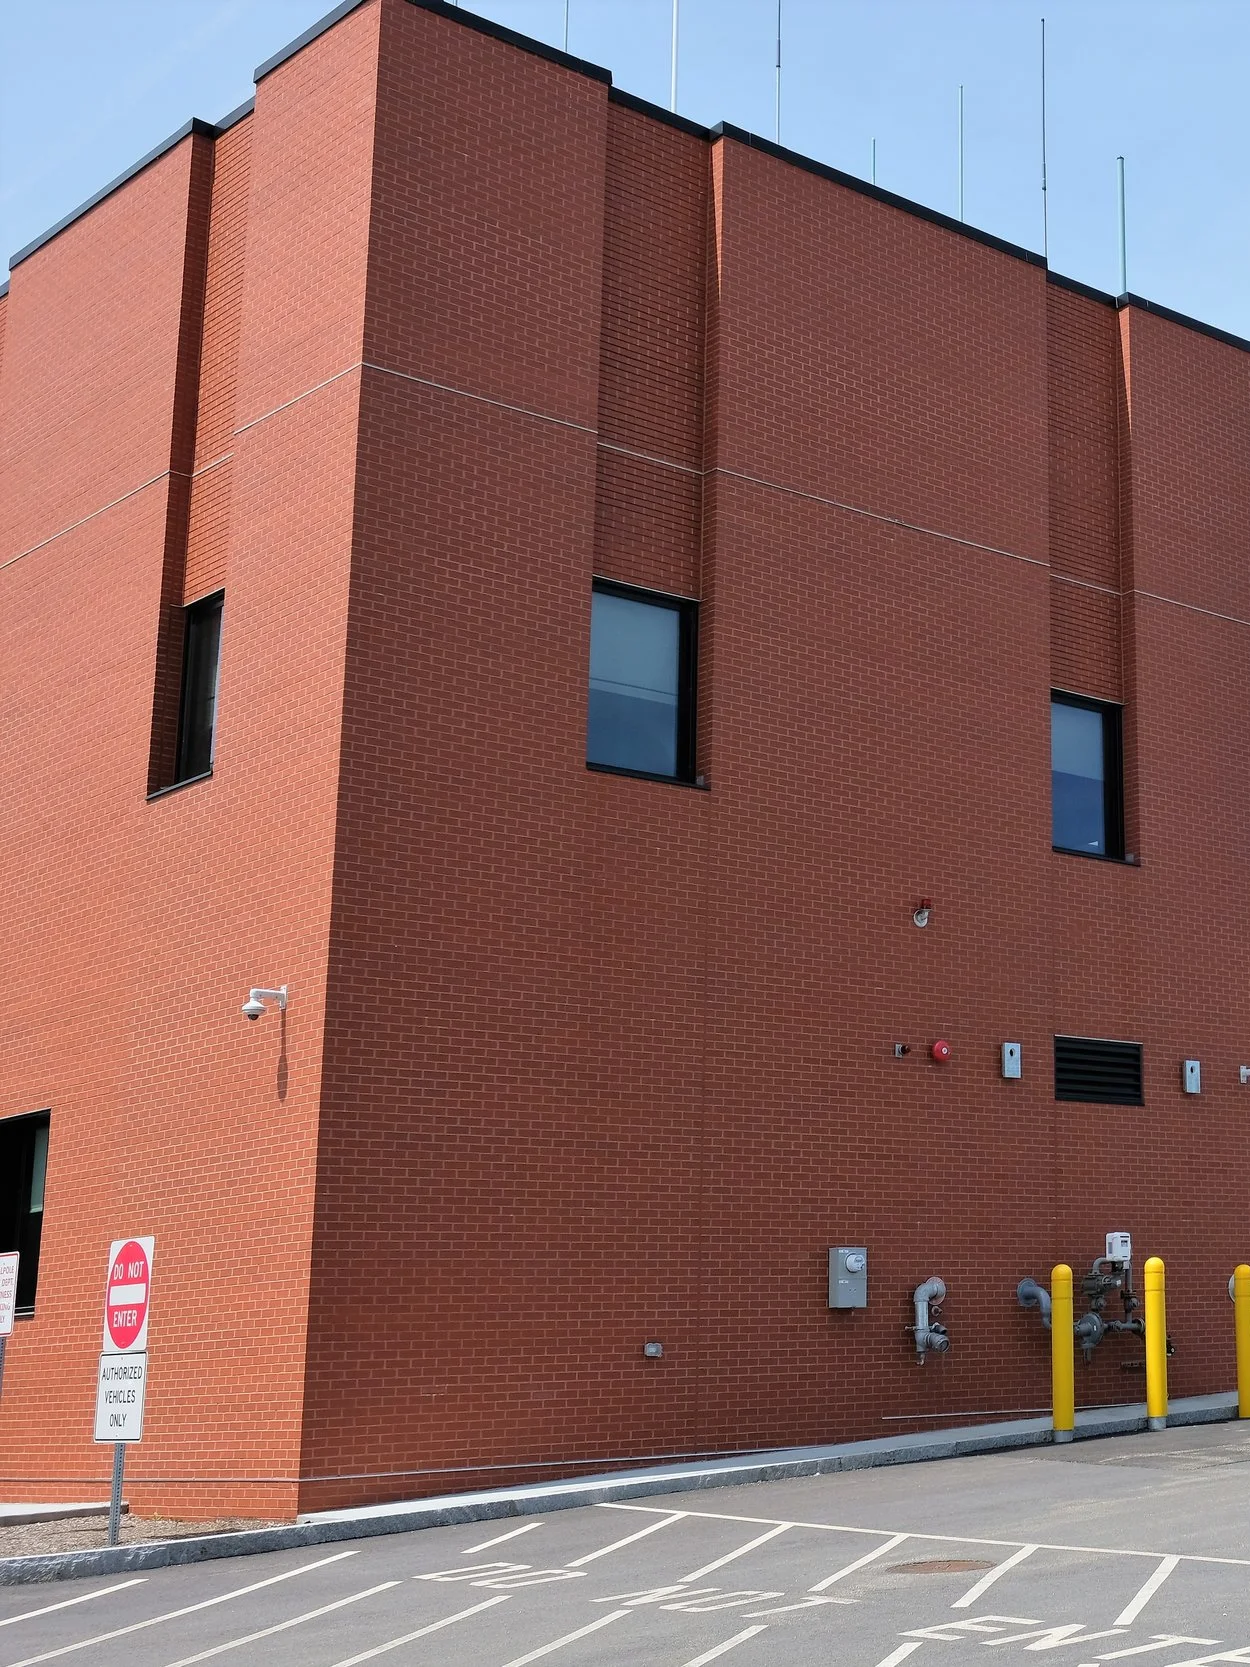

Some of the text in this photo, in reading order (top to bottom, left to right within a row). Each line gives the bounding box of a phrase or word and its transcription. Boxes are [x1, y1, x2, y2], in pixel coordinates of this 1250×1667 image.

[113, 1261, 144, 1280] DO NOT
[113, 1310, 137, 1328] ENTER
[101, 1366, 143, 1381] AUTHORIZED
[104, 1389, 136, 1404] VEHICLES
[109, 1413, 127, 1427] ONLY
[411, 1562, 588, 1589] DO
[589, 1585, 862, 1618] NOT
